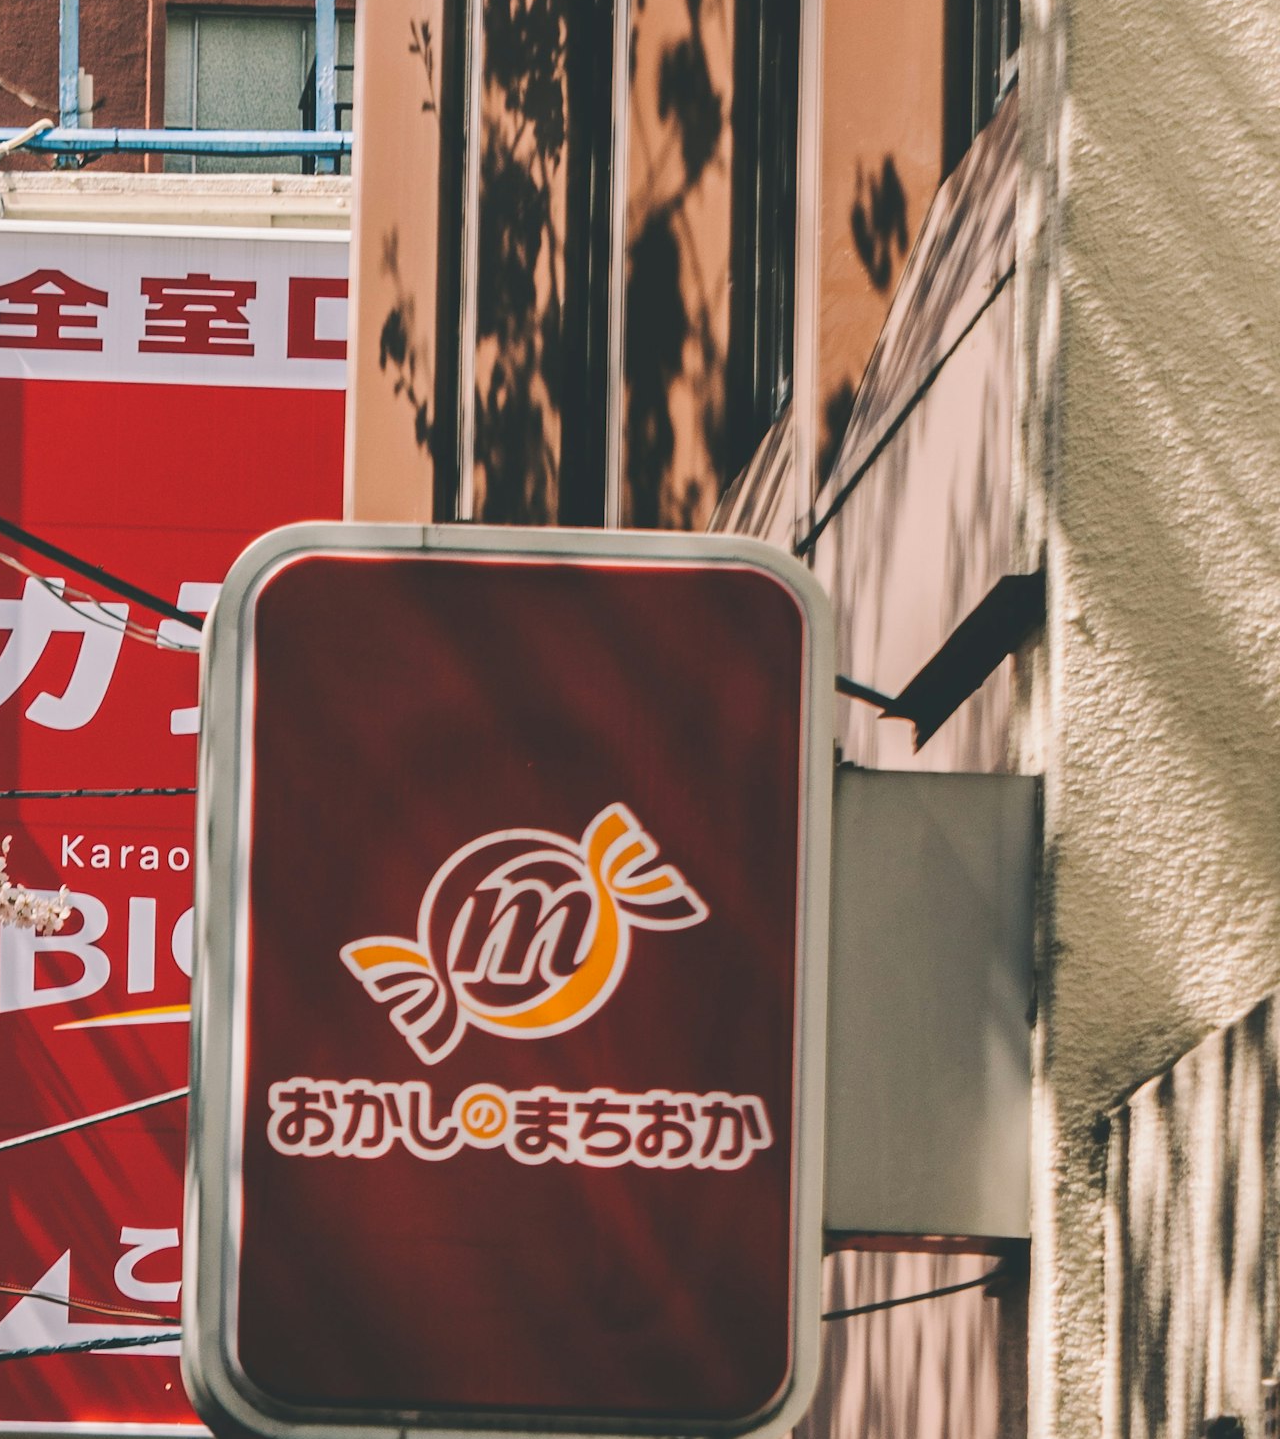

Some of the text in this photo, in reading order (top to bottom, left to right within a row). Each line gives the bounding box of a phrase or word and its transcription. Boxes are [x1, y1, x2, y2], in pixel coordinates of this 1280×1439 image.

[61, 835, 190, 871] Karao
[270, 1079, 770, 1169] おかしのまちおか
